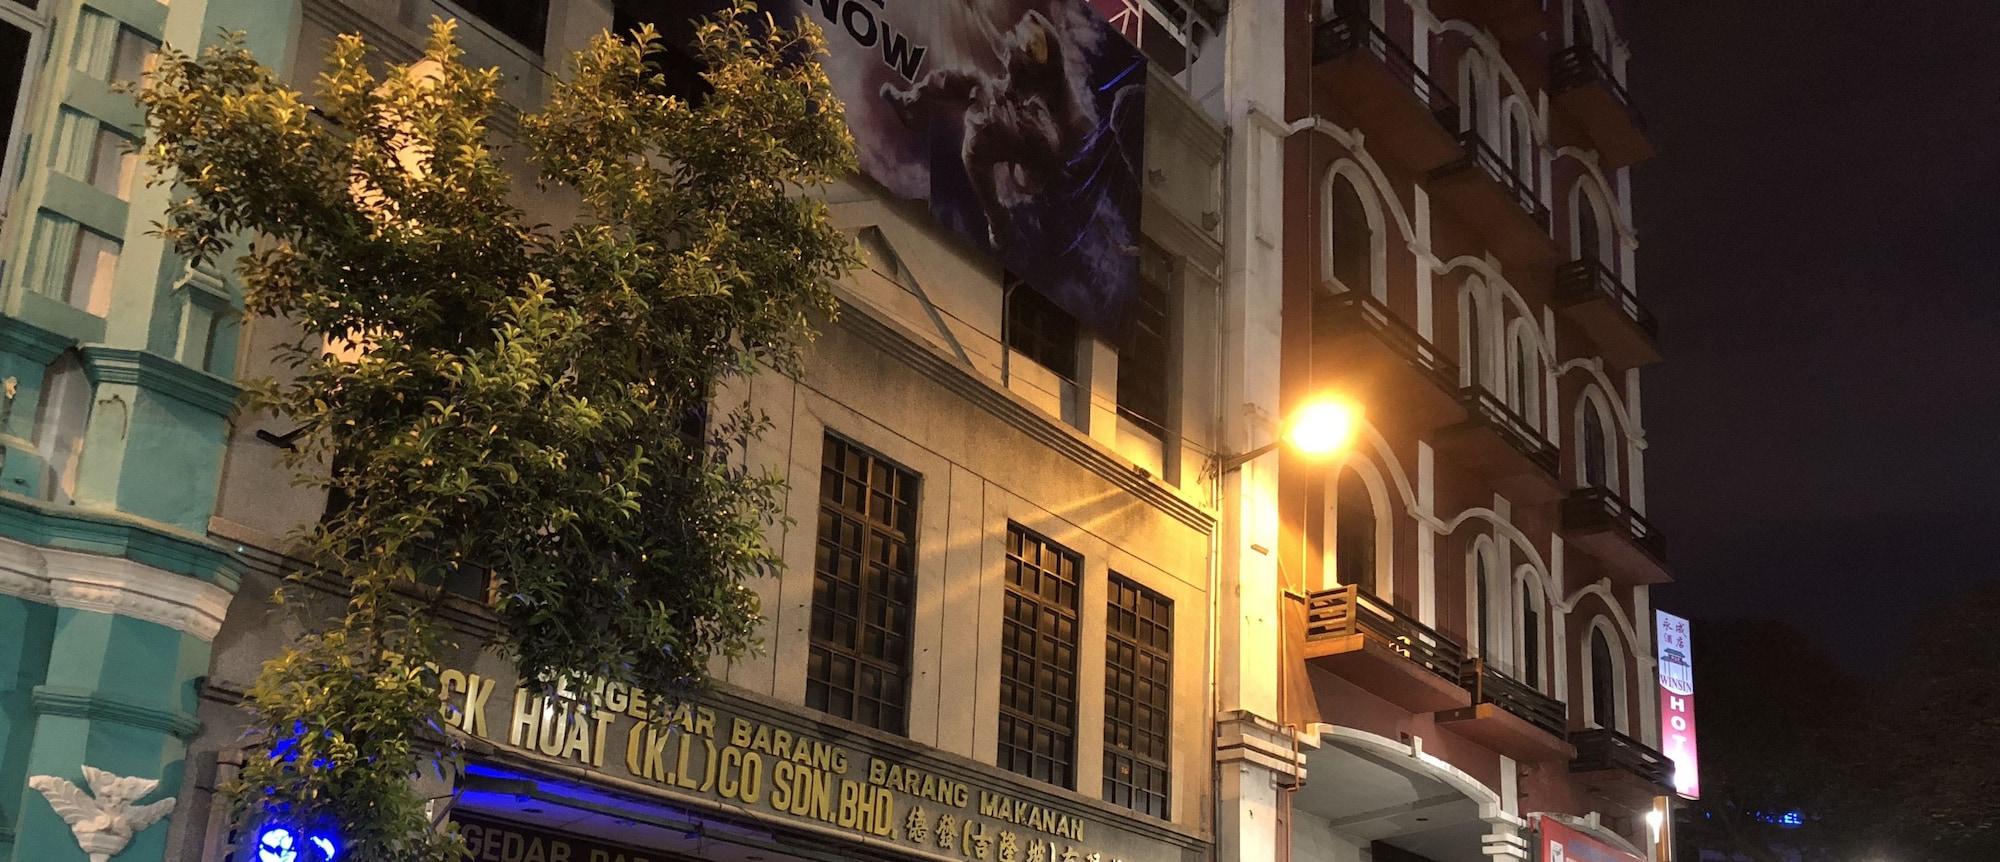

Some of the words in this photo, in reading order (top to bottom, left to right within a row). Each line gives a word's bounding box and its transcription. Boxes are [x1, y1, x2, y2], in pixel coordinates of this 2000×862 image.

[1659, 674, 1692, 693] WINSIN
[511, 687, 616, 767] HUAT
[730, 716, 848, 774] BARANG
[868, 757, 969, 808] BARANG
[979, 791, 1085, 842] MAKANAN
[905, 805, 1122, 862] 德發(吉隆坡)
